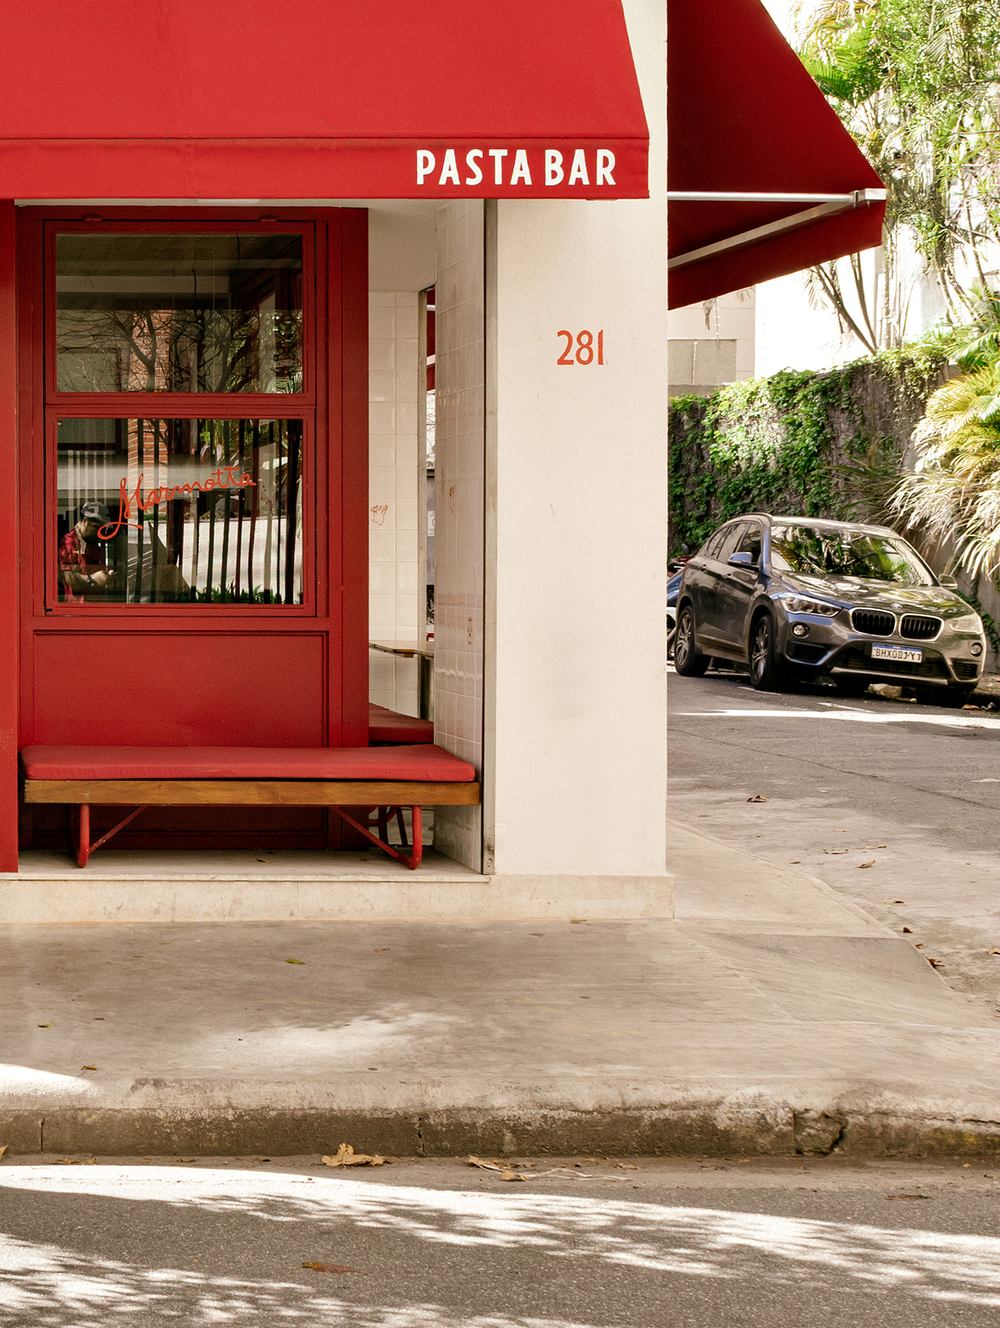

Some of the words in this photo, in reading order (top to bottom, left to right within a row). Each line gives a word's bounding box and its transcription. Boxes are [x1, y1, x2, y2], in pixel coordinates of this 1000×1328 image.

[416, 148, 533, 186] PASTA
[544, 148, 617, 186] BAR
[556, 329, 604, 366] 281
[96, 466, 258, 541] Marmotta
